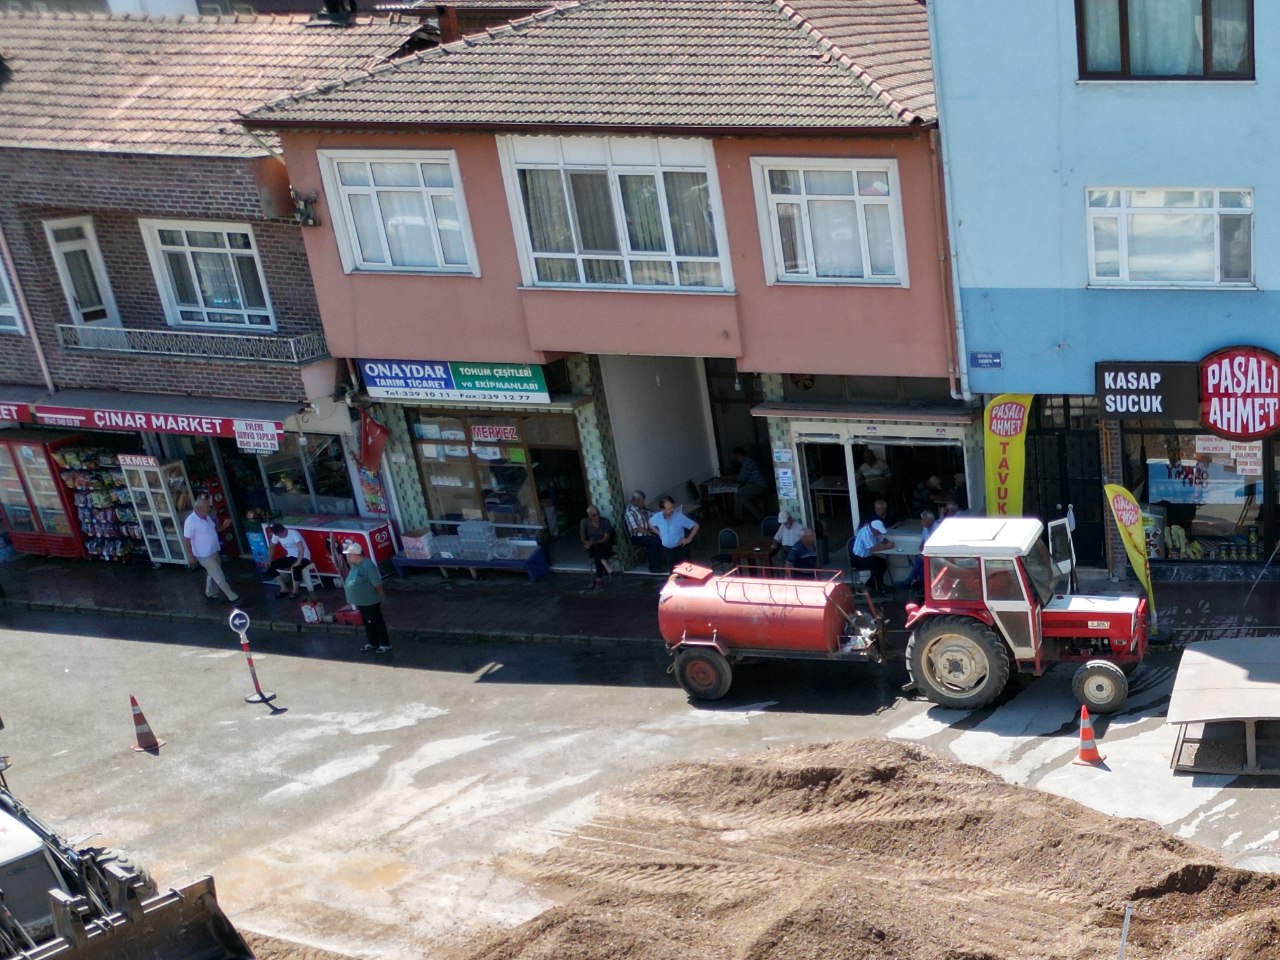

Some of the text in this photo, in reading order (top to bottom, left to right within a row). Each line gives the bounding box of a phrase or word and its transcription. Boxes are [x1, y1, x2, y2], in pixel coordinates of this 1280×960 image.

[365, 363, 448, 378] ONAYDAR
[459, 367, 491, 376] TOHUM
[1208, 356, 1278, 397] PAŞALI
[374, 378, 405, 387] TARIM
[1104, 372, 1161, 389] KASAP
[1105, 395, 1163, 412] SUCUK
[0, 406, 18, 420] ET
[1209, 397, 1278, 433] AHMET
[94, 412, 222, 434] ÇINAR MARKET
[991, 420, 1022, 435] AHMET
[471, 425, 517, 440] MERKEZ
[118, 455, 156, 467] EKMEK
[997, 442, 1009, 515] TAVUK
